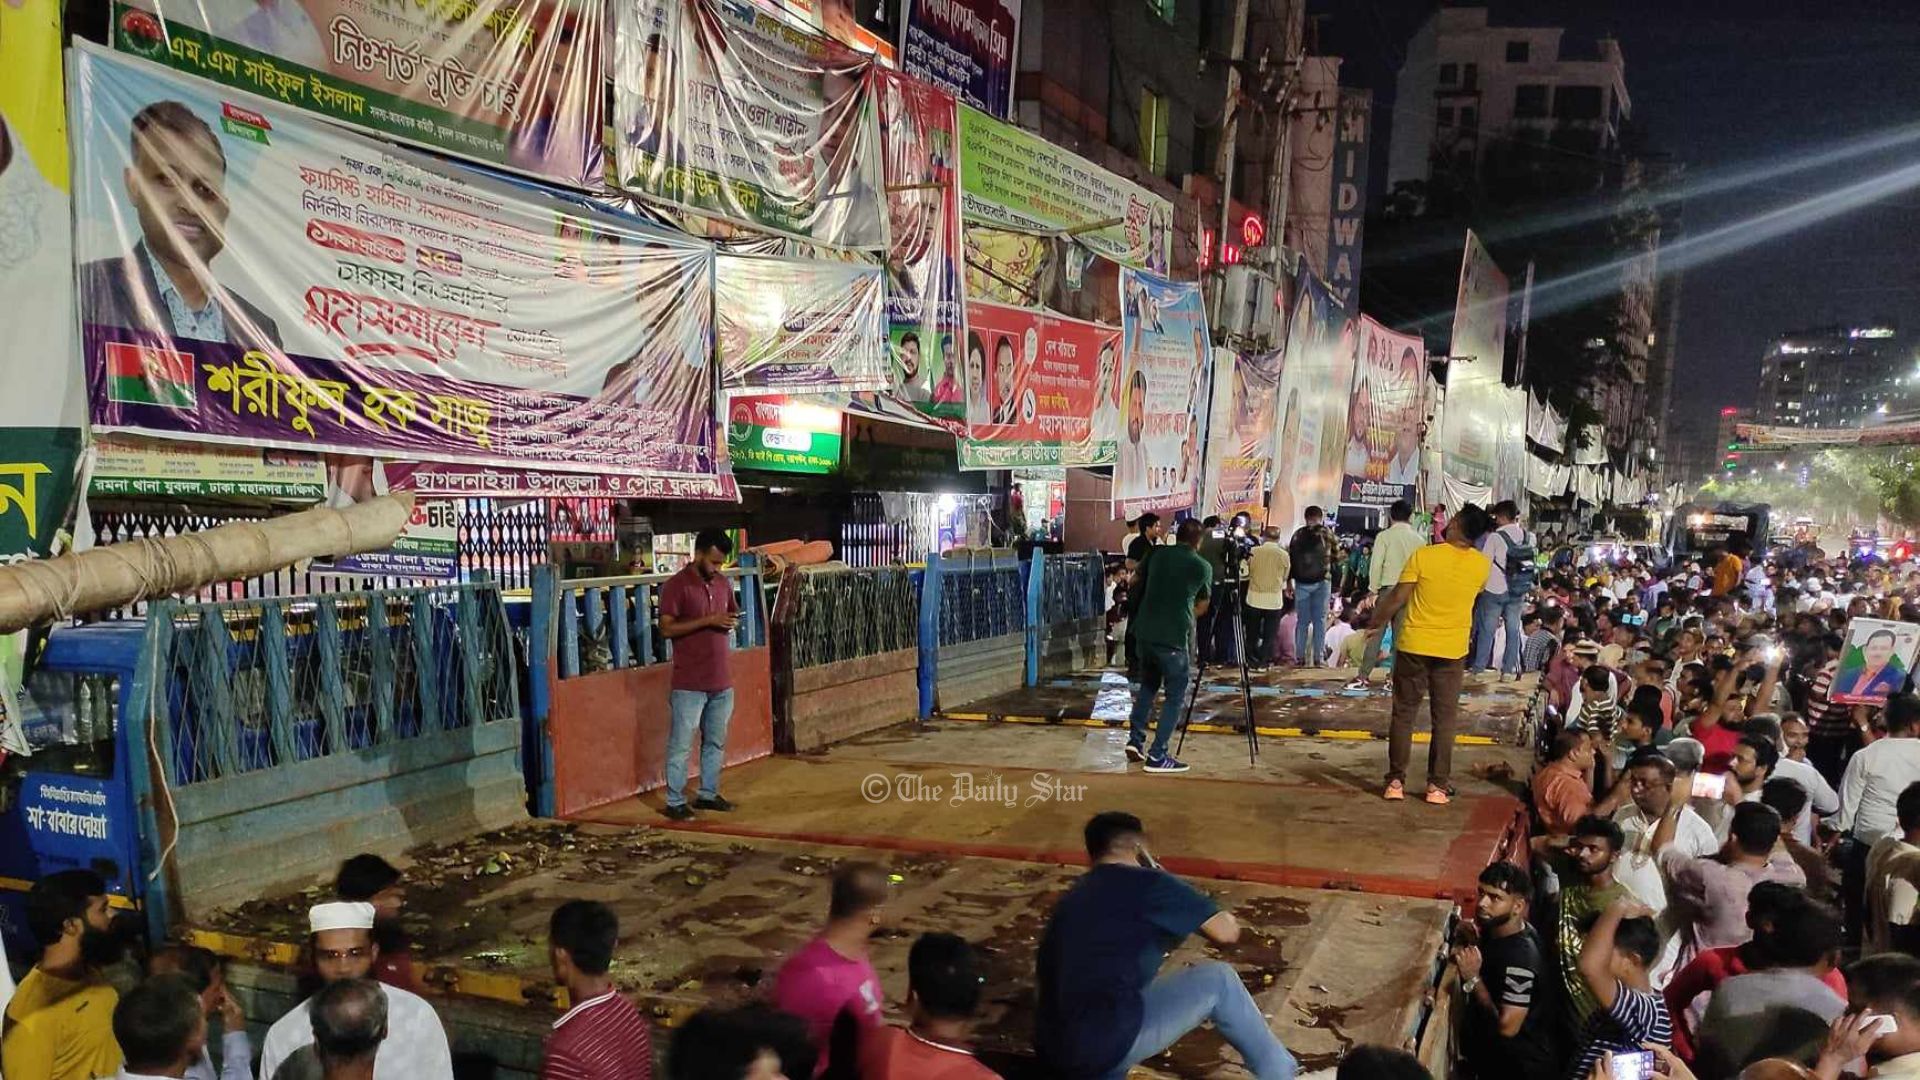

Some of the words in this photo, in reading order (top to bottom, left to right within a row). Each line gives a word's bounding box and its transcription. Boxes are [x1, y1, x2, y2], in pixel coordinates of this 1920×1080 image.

[170, 37, 237, 77] এম.এম
[243, 57, 306, 101] সাইফুল
[309, 74, 366, 115] ইসলাম
[330, 15, 421, 84] নিঃশর্ত
[423, 55, 477, 107] মুক্তি
[480, 76, 521, 121] চাই
[302, 190, 352, 222] নির্দলীয়
[336, 260, 405, 292] ঢাকায়
[201, 350, 351, 440] শরীফুল
[360, 382, 417, 432] হক
[755, 401, 782, 421] বাংলাদে
[95, 478, 129, 492] রমনা
[133, 478, 160, 494] থানা
[164, 481, 205, 496] যুবদল,
[210, 481, 236, 496] ঢাকা
[239, 483, 282, 498] মহানগর
[412, 467, 519, 491] ছাগলনাইয়া
[526, 470, 600, 494] উপজেলা
[607, 477, 621, 491] ও
[627, 473, 665, 495] পৌর
[427, 499, 456, 528] চাই
[393, 554, 418, 567] থানা
[78, 813, 107, 840] দোয়া
